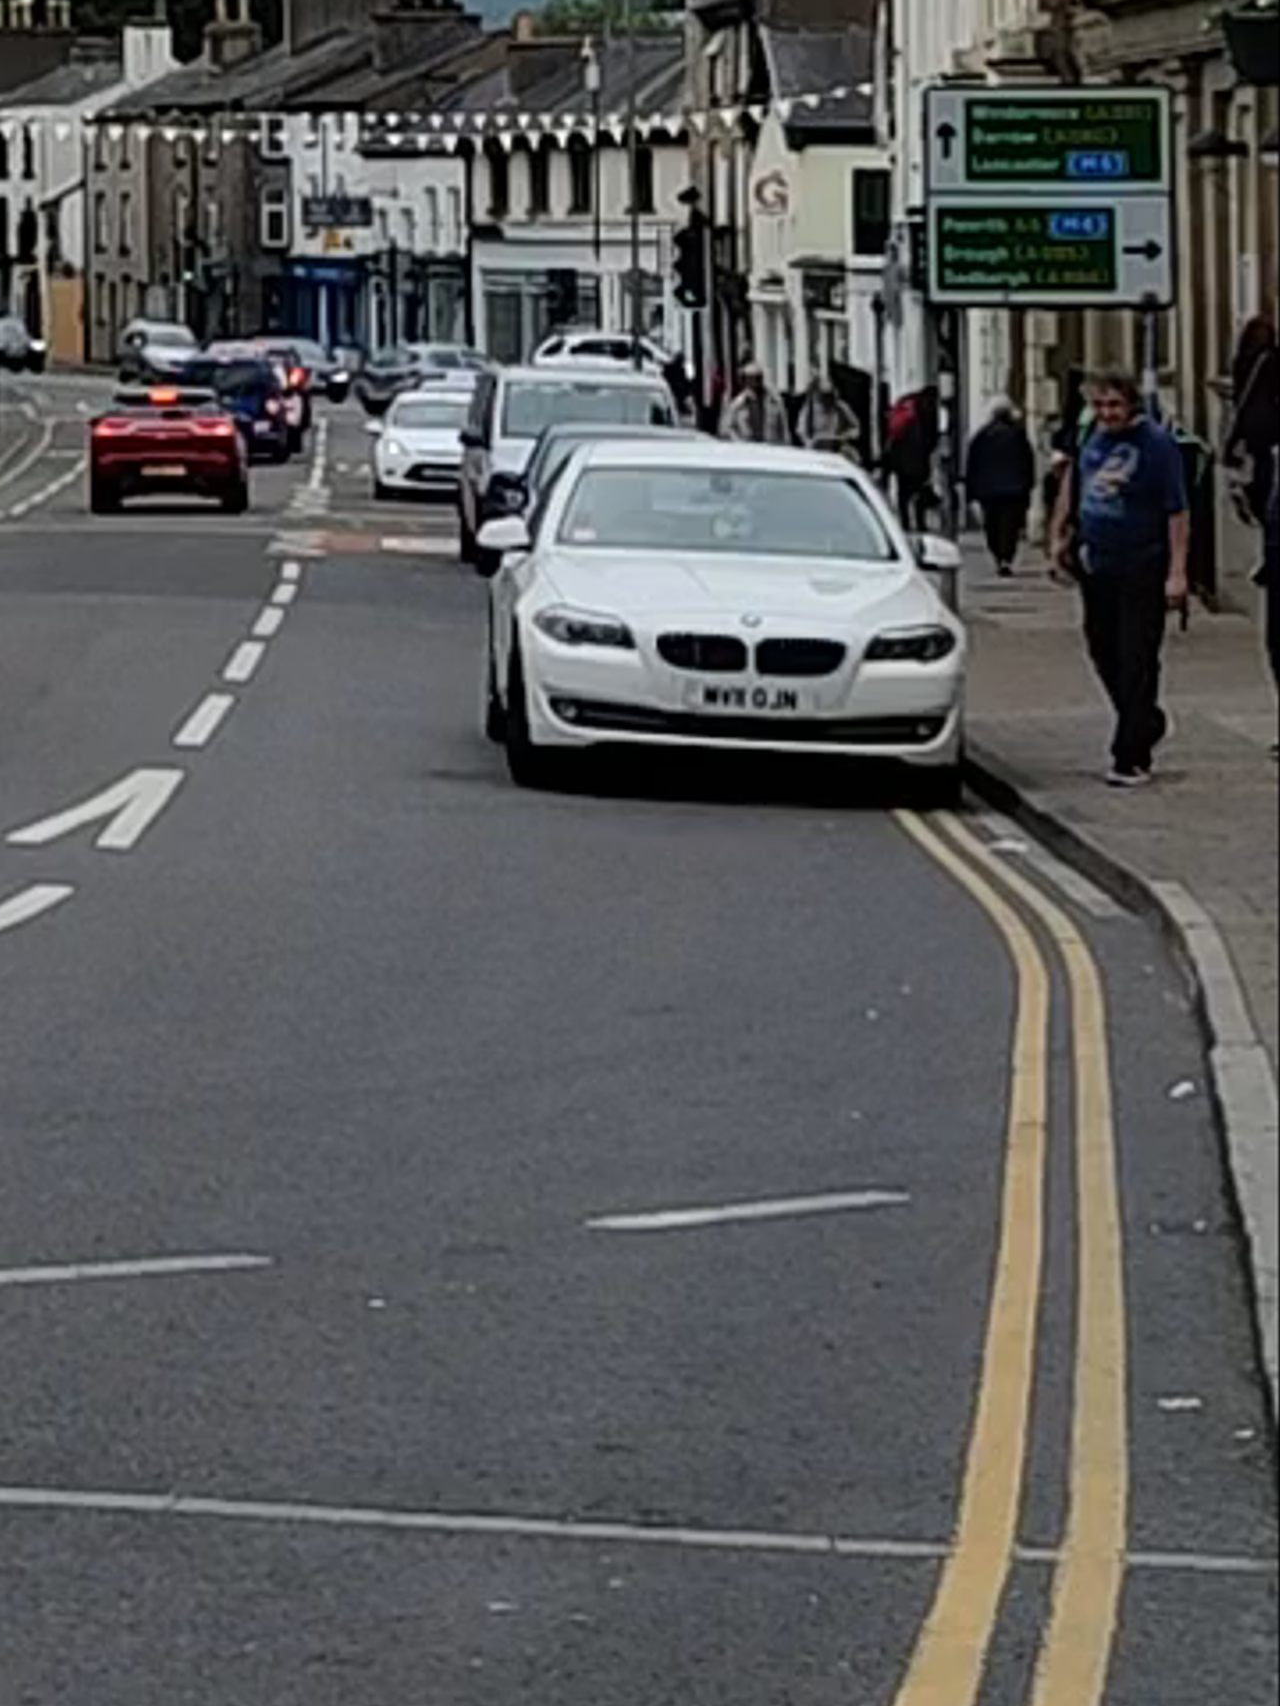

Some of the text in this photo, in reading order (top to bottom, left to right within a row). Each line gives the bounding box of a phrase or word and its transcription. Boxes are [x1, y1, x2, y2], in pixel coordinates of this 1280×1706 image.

[971, 127, 1119, 145] Barrow (A)
[971, 156, 1061, 172] Lancaster
[943, 217, 1009, 233] Penrith
[943, 244, 1009, 265] Brough
[944, 269, 1031, 287] Sedbergh
